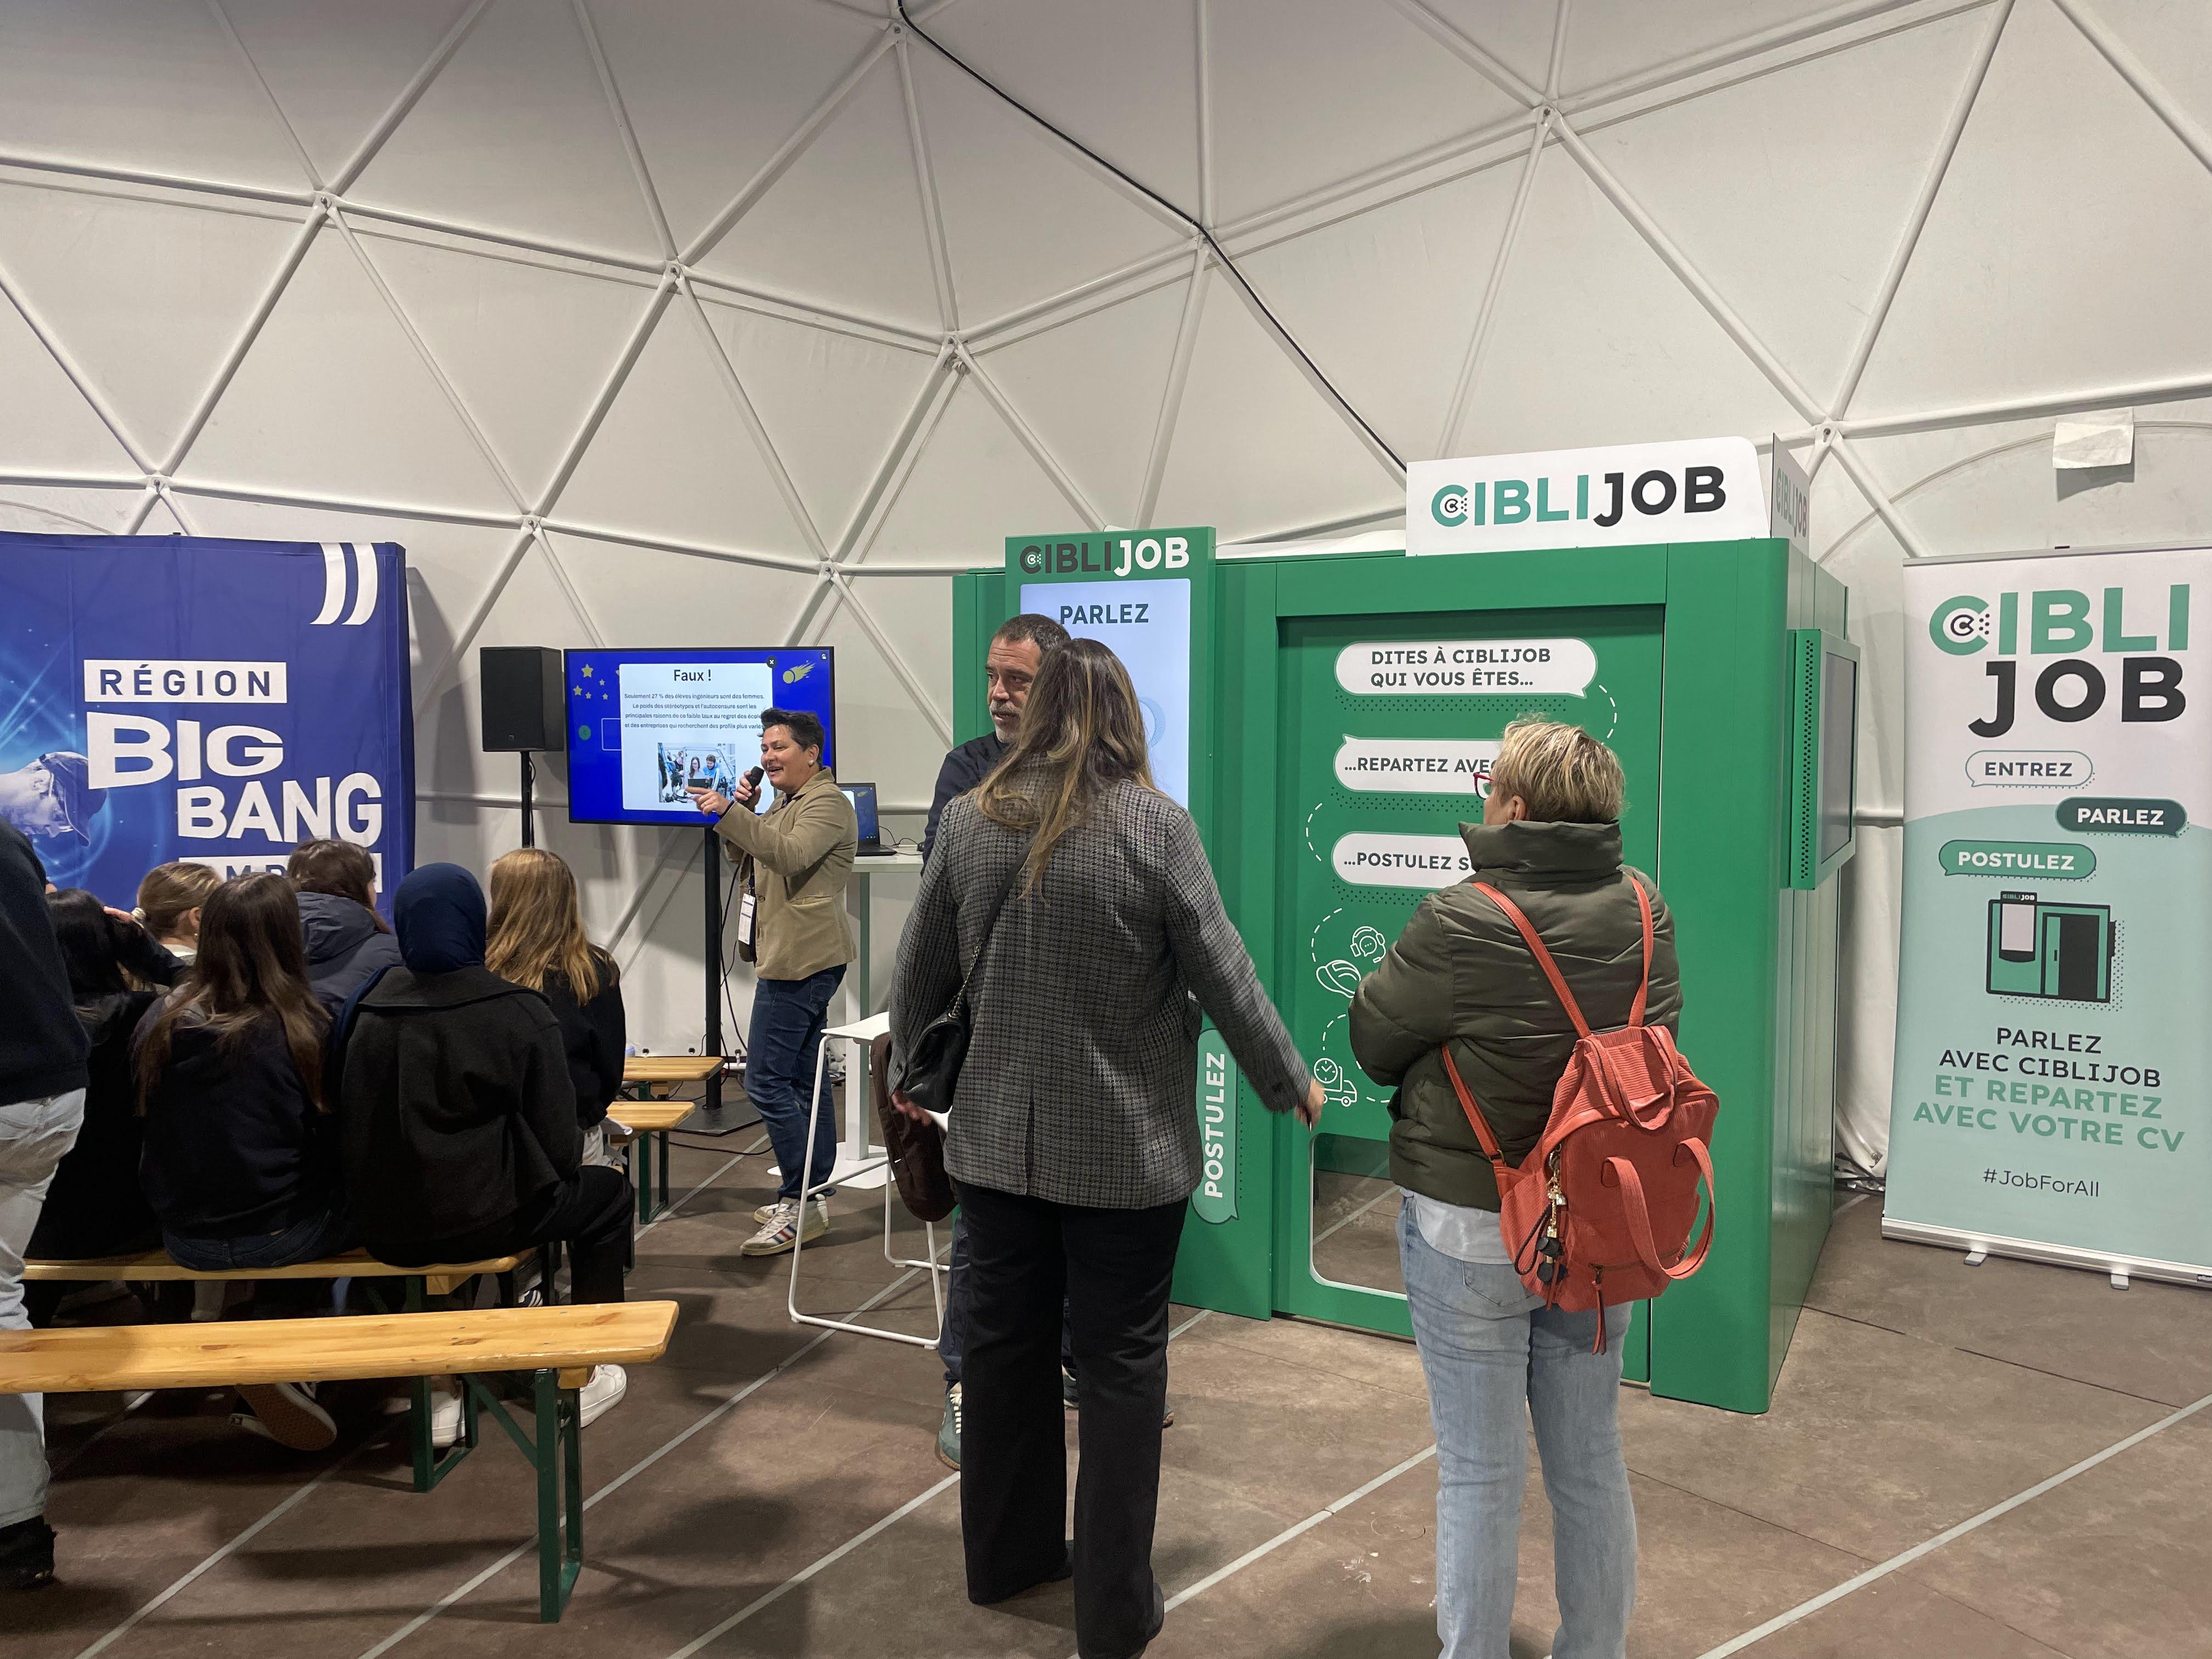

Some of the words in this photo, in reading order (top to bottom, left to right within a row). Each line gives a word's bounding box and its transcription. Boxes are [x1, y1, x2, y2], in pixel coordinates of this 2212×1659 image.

[1431, 466, 1726, 528] CIBLIJOB
[1776, 468, 1807, 538] CIBLIJOB
[1020, 537, 1189, 577] CIBLIJOB
[1060, 603, 1149, 624] PARLEZ
[1929, 584, 2190, 656] CIBLI
[1372, 651, 1427, 665] DITES
[1434, 646, 1446, 664] À
[1452, 648, 1551, 664] CIBLIJOB
[100, 664, 270, 697] RÉGION
[674, 669, 704, 681] Faux
[708, 669, 712, 681] !
[1370, 673, 1407, 687] QUI
[1414, 672, 1465, 686] VOUS
[1472, 668, 1533, 686] ÊTES...
[1968, 657, 2187, 738] JOB
[87, 712, 284, 790] BIG
[1344, 757, 1448, 772] ...REPARTEZ
[1454, 758, 1497, 773] AVE
[1985, 762, 2073, 777] ENTREZ
[177, 772, 382, 847] BANG
[2077, 808, 2164, 826] PARLEZ
[1344, 853, 1452, 870] ...POSTULEZ
[1958, 851, 2074, 871] POSTULEZ
[1997, 1027, 2102, 1054] PARLEZ
[1939, 1050, 2009, 1072] AVEC
[2018, 1057, 2162, 1087] CIBLIJOB
[1935, 1075, 1974, 1097] ET
[1987, 1079, 2163, 1119] REPARTEZ
[1204, 1052, 1225, 1198] POSTULEZ
[1913, 1102, 1997, 1130] AVEC
[2009, 1111, 2123, 1146] VOTRE
[2137, 1126, 2186, 1152] CV
[1982, 1169, 2100, 1197] #JobForAll
